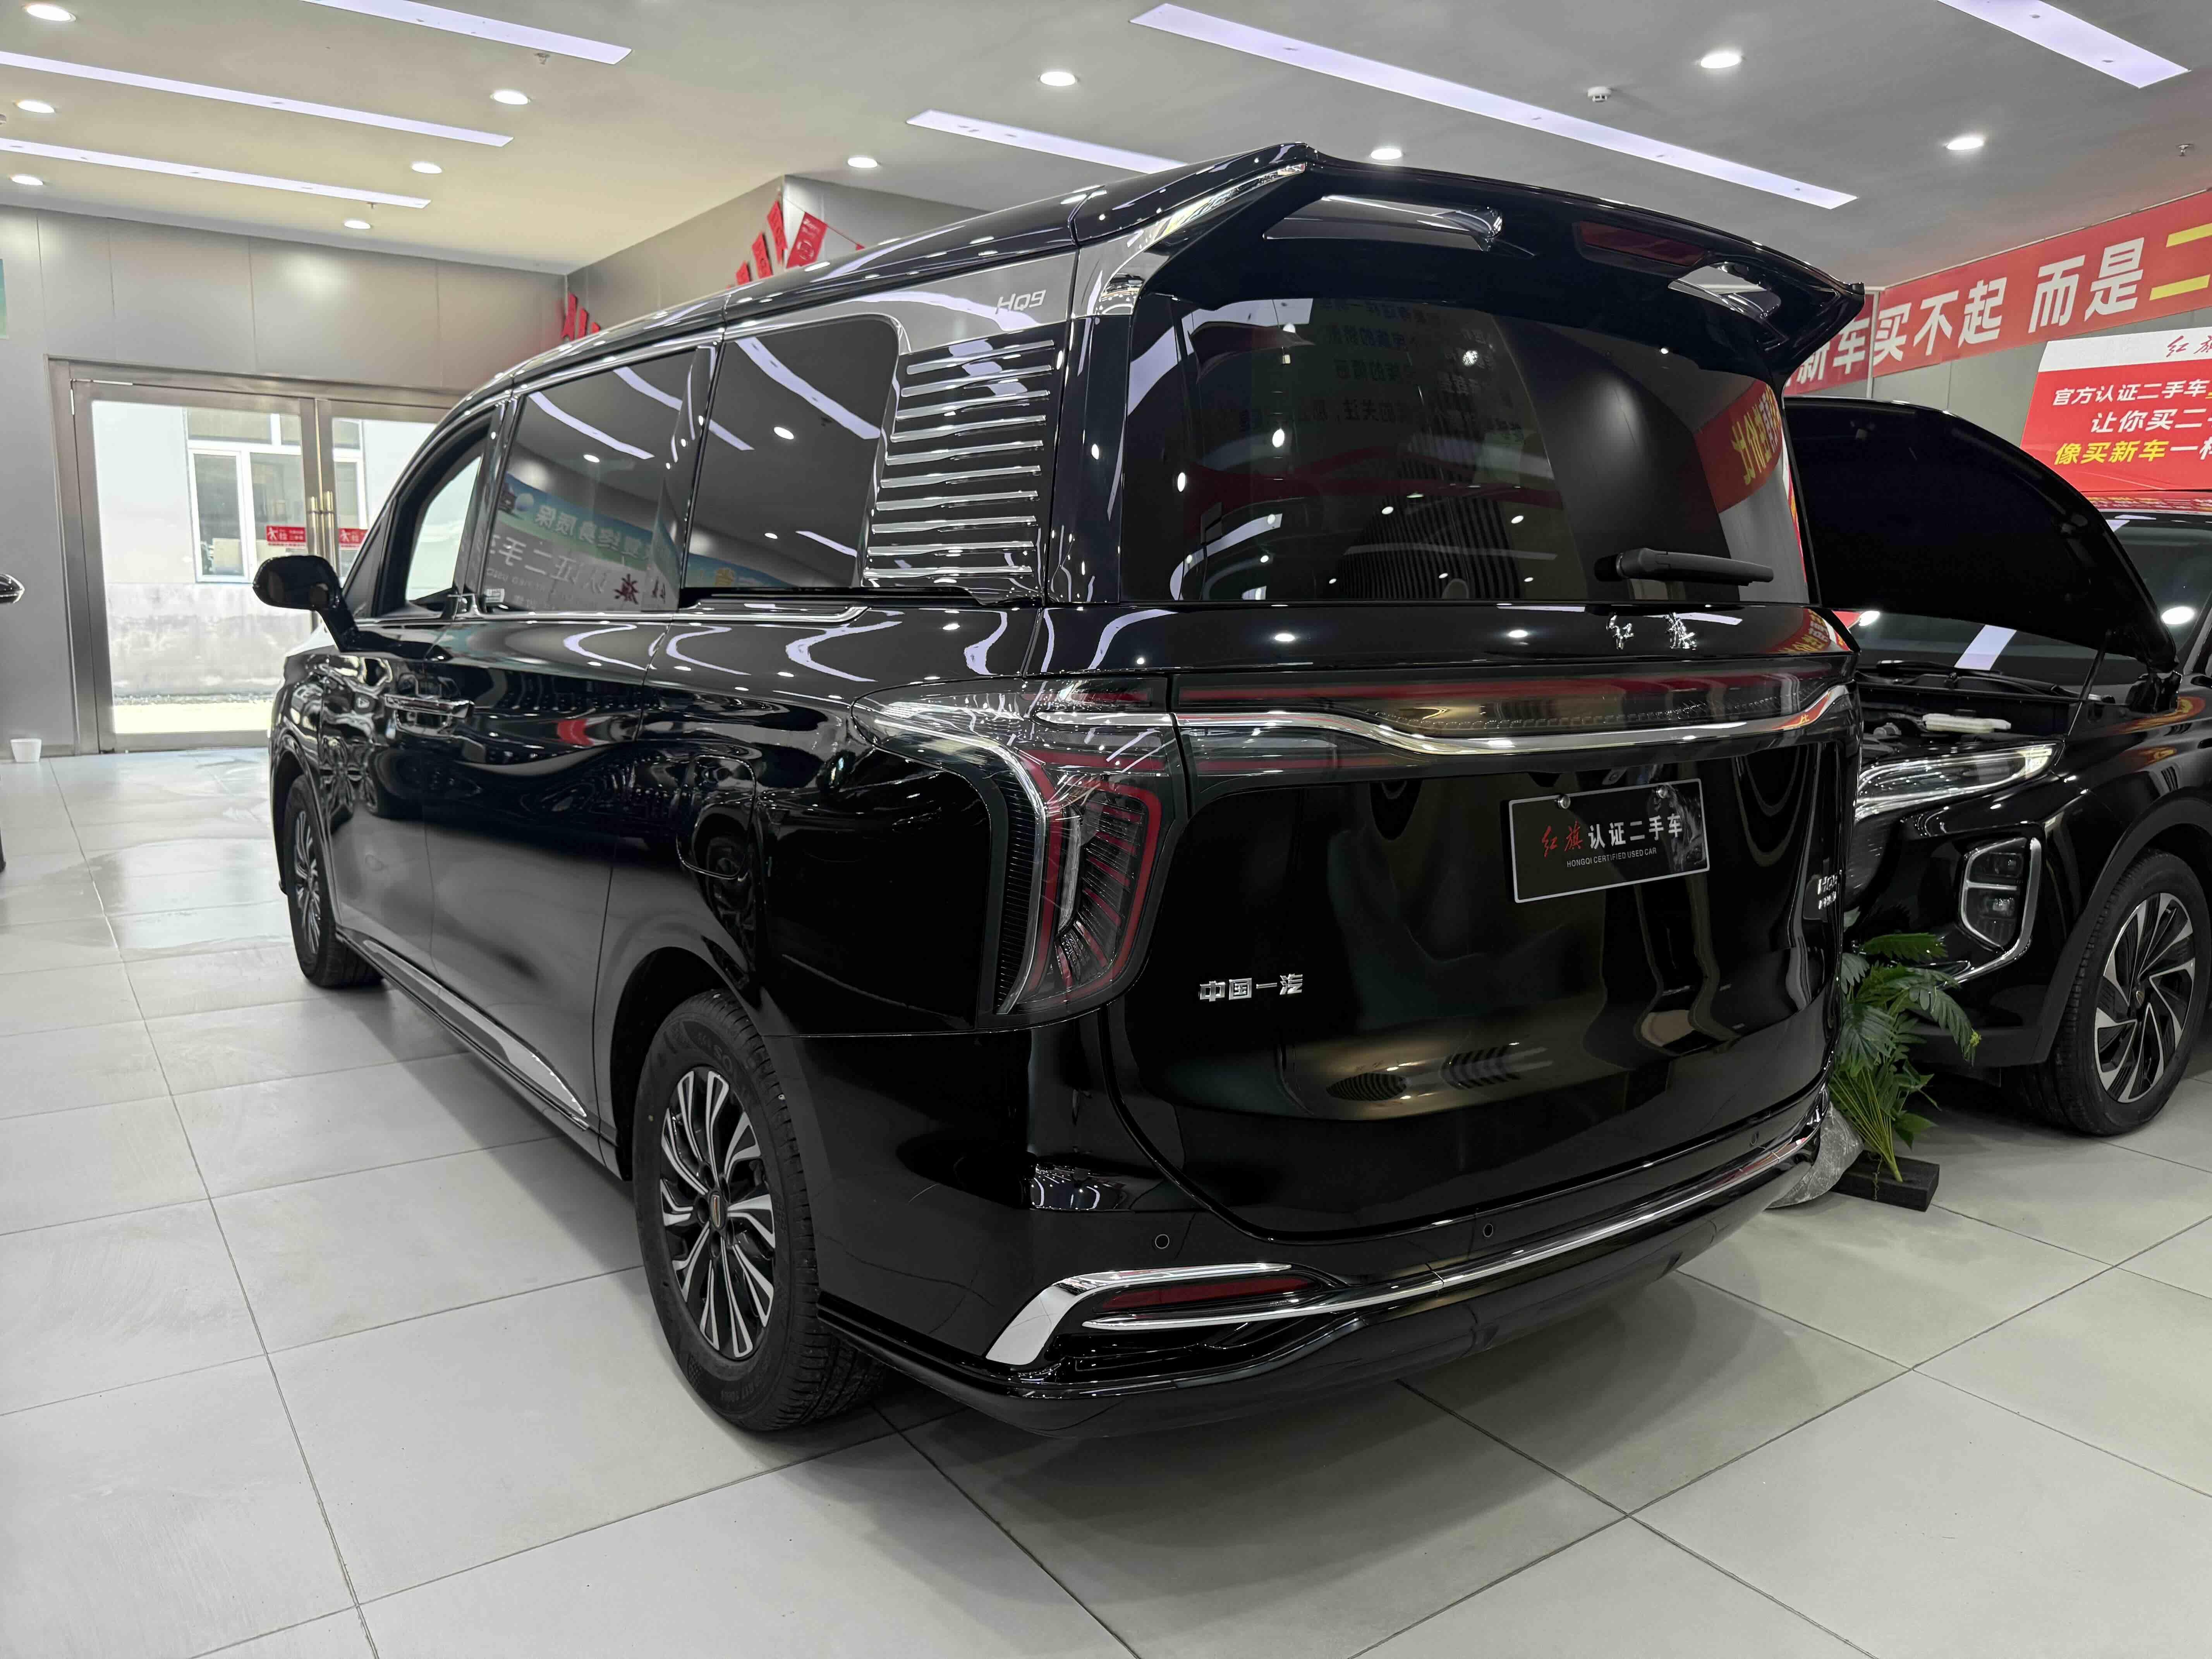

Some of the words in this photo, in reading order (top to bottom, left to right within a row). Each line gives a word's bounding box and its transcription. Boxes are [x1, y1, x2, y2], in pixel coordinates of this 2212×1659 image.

[996, 290, 1046, 314] HQ9
[1786, 277, 2007, 386] 新车买不起
[2028, 223, 2212, 333] 而是二
[2053, 379, 2212, 405] 官方认证二手车
[2091, 409, 2212, 433] 让你买二
[1567, 857, 1592, 867] HONGQI
[1594, 852, 1626, 864] CERTIFIED
[1627, 849, 1644, 859] USED
[1645, 847, 1657, 856] CAR
[1199, 973, 1303, 1002] 中国一汽
